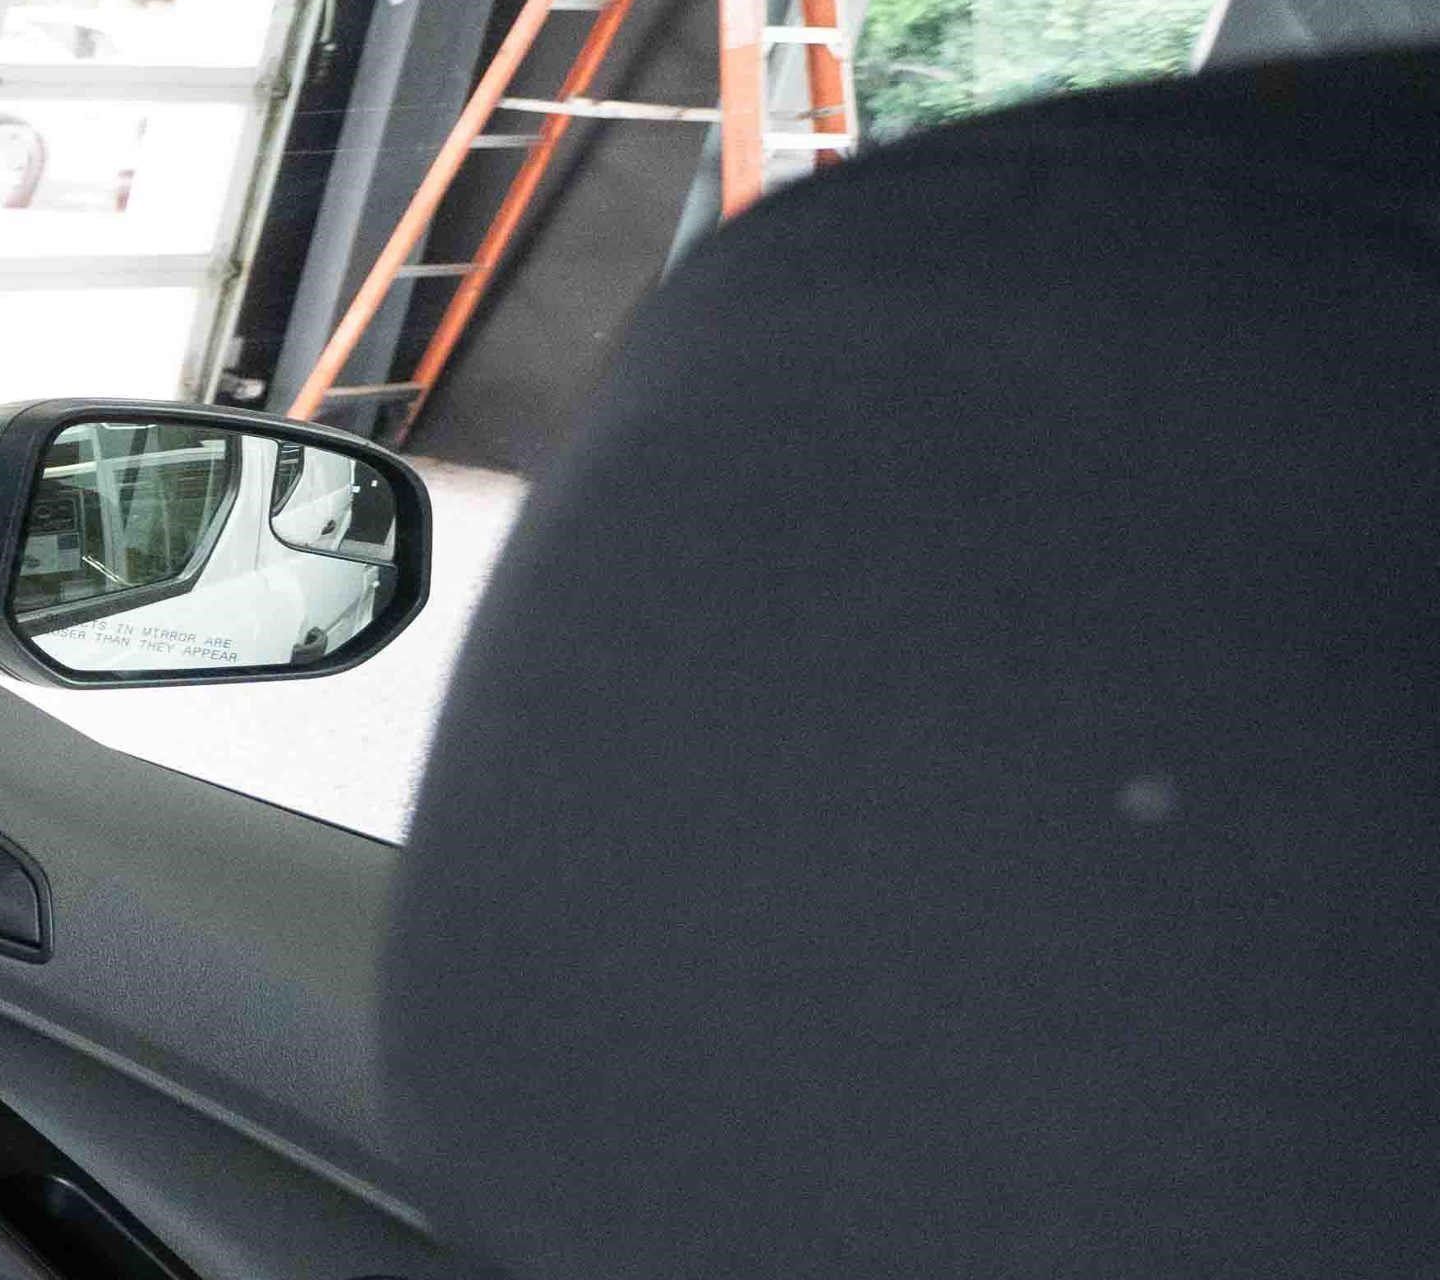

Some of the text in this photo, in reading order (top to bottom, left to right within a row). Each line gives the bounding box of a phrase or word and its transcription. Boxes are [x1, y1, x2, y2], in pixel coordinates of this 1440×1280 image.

[96, 632, 130, 647] THAN
[139, 639, 175, 654] THEY
[183, 645, 238, 663] APPEAR
[142, 627, 197, 644] MIRROR
[203, 636, 233, 649] ARE
